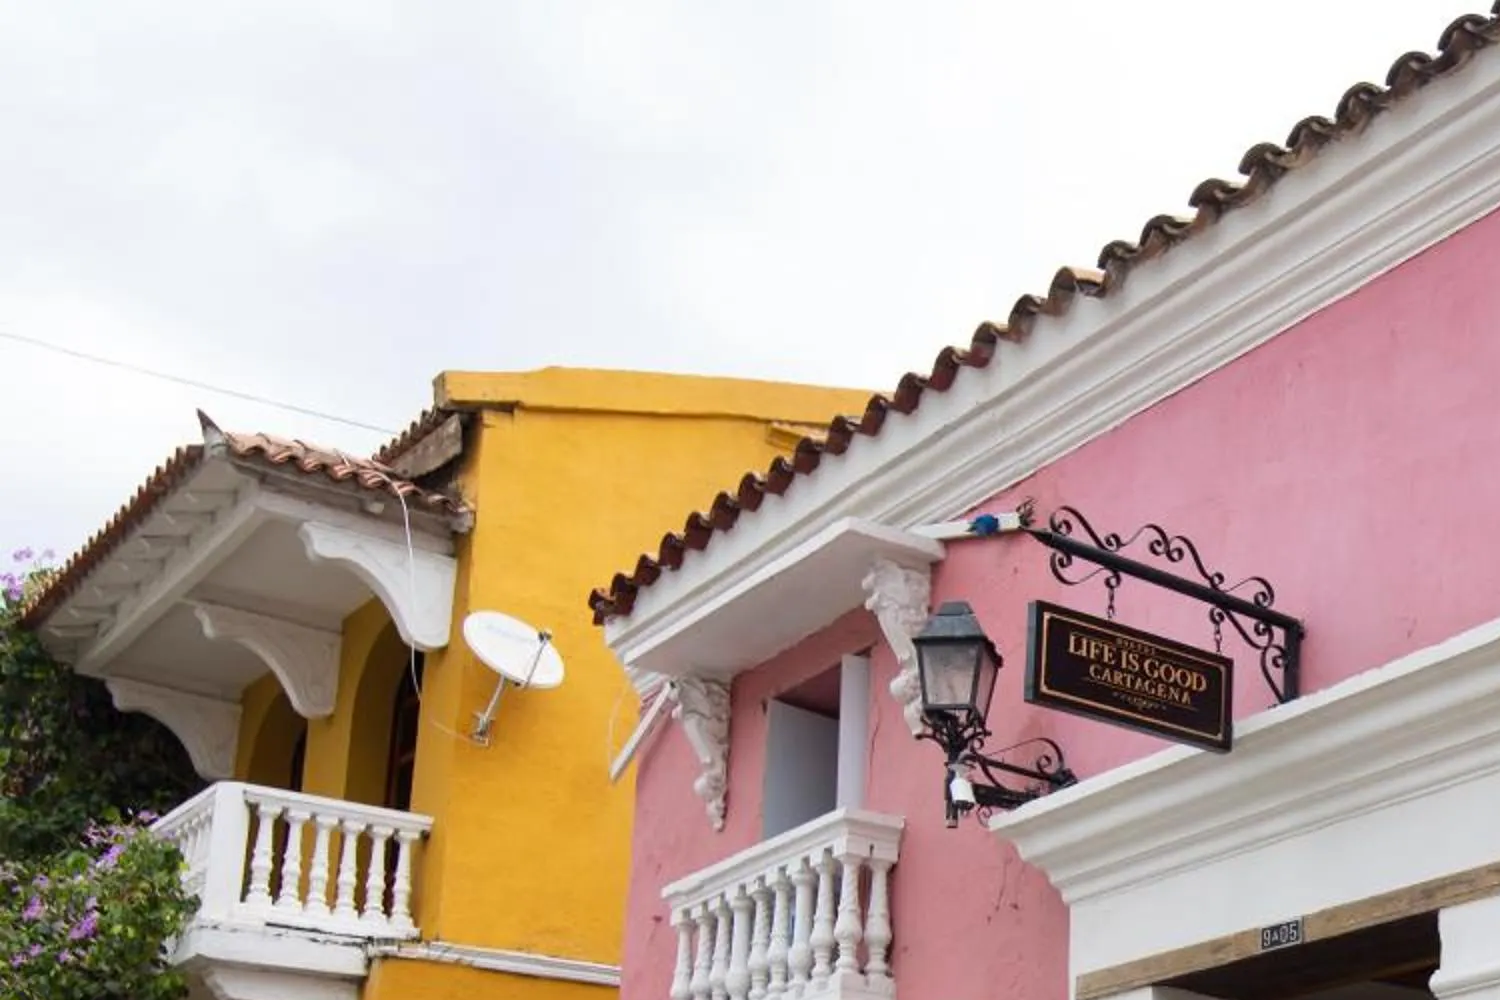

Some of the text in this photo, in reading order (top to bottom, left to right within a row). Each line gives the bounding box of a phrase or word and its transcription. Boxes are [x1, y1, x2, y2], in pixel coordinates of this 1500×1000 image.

[1068, 634, 1207, 692] LIFE IS GOOD
[1089, 664, 1191, 704] CARTAGENA
